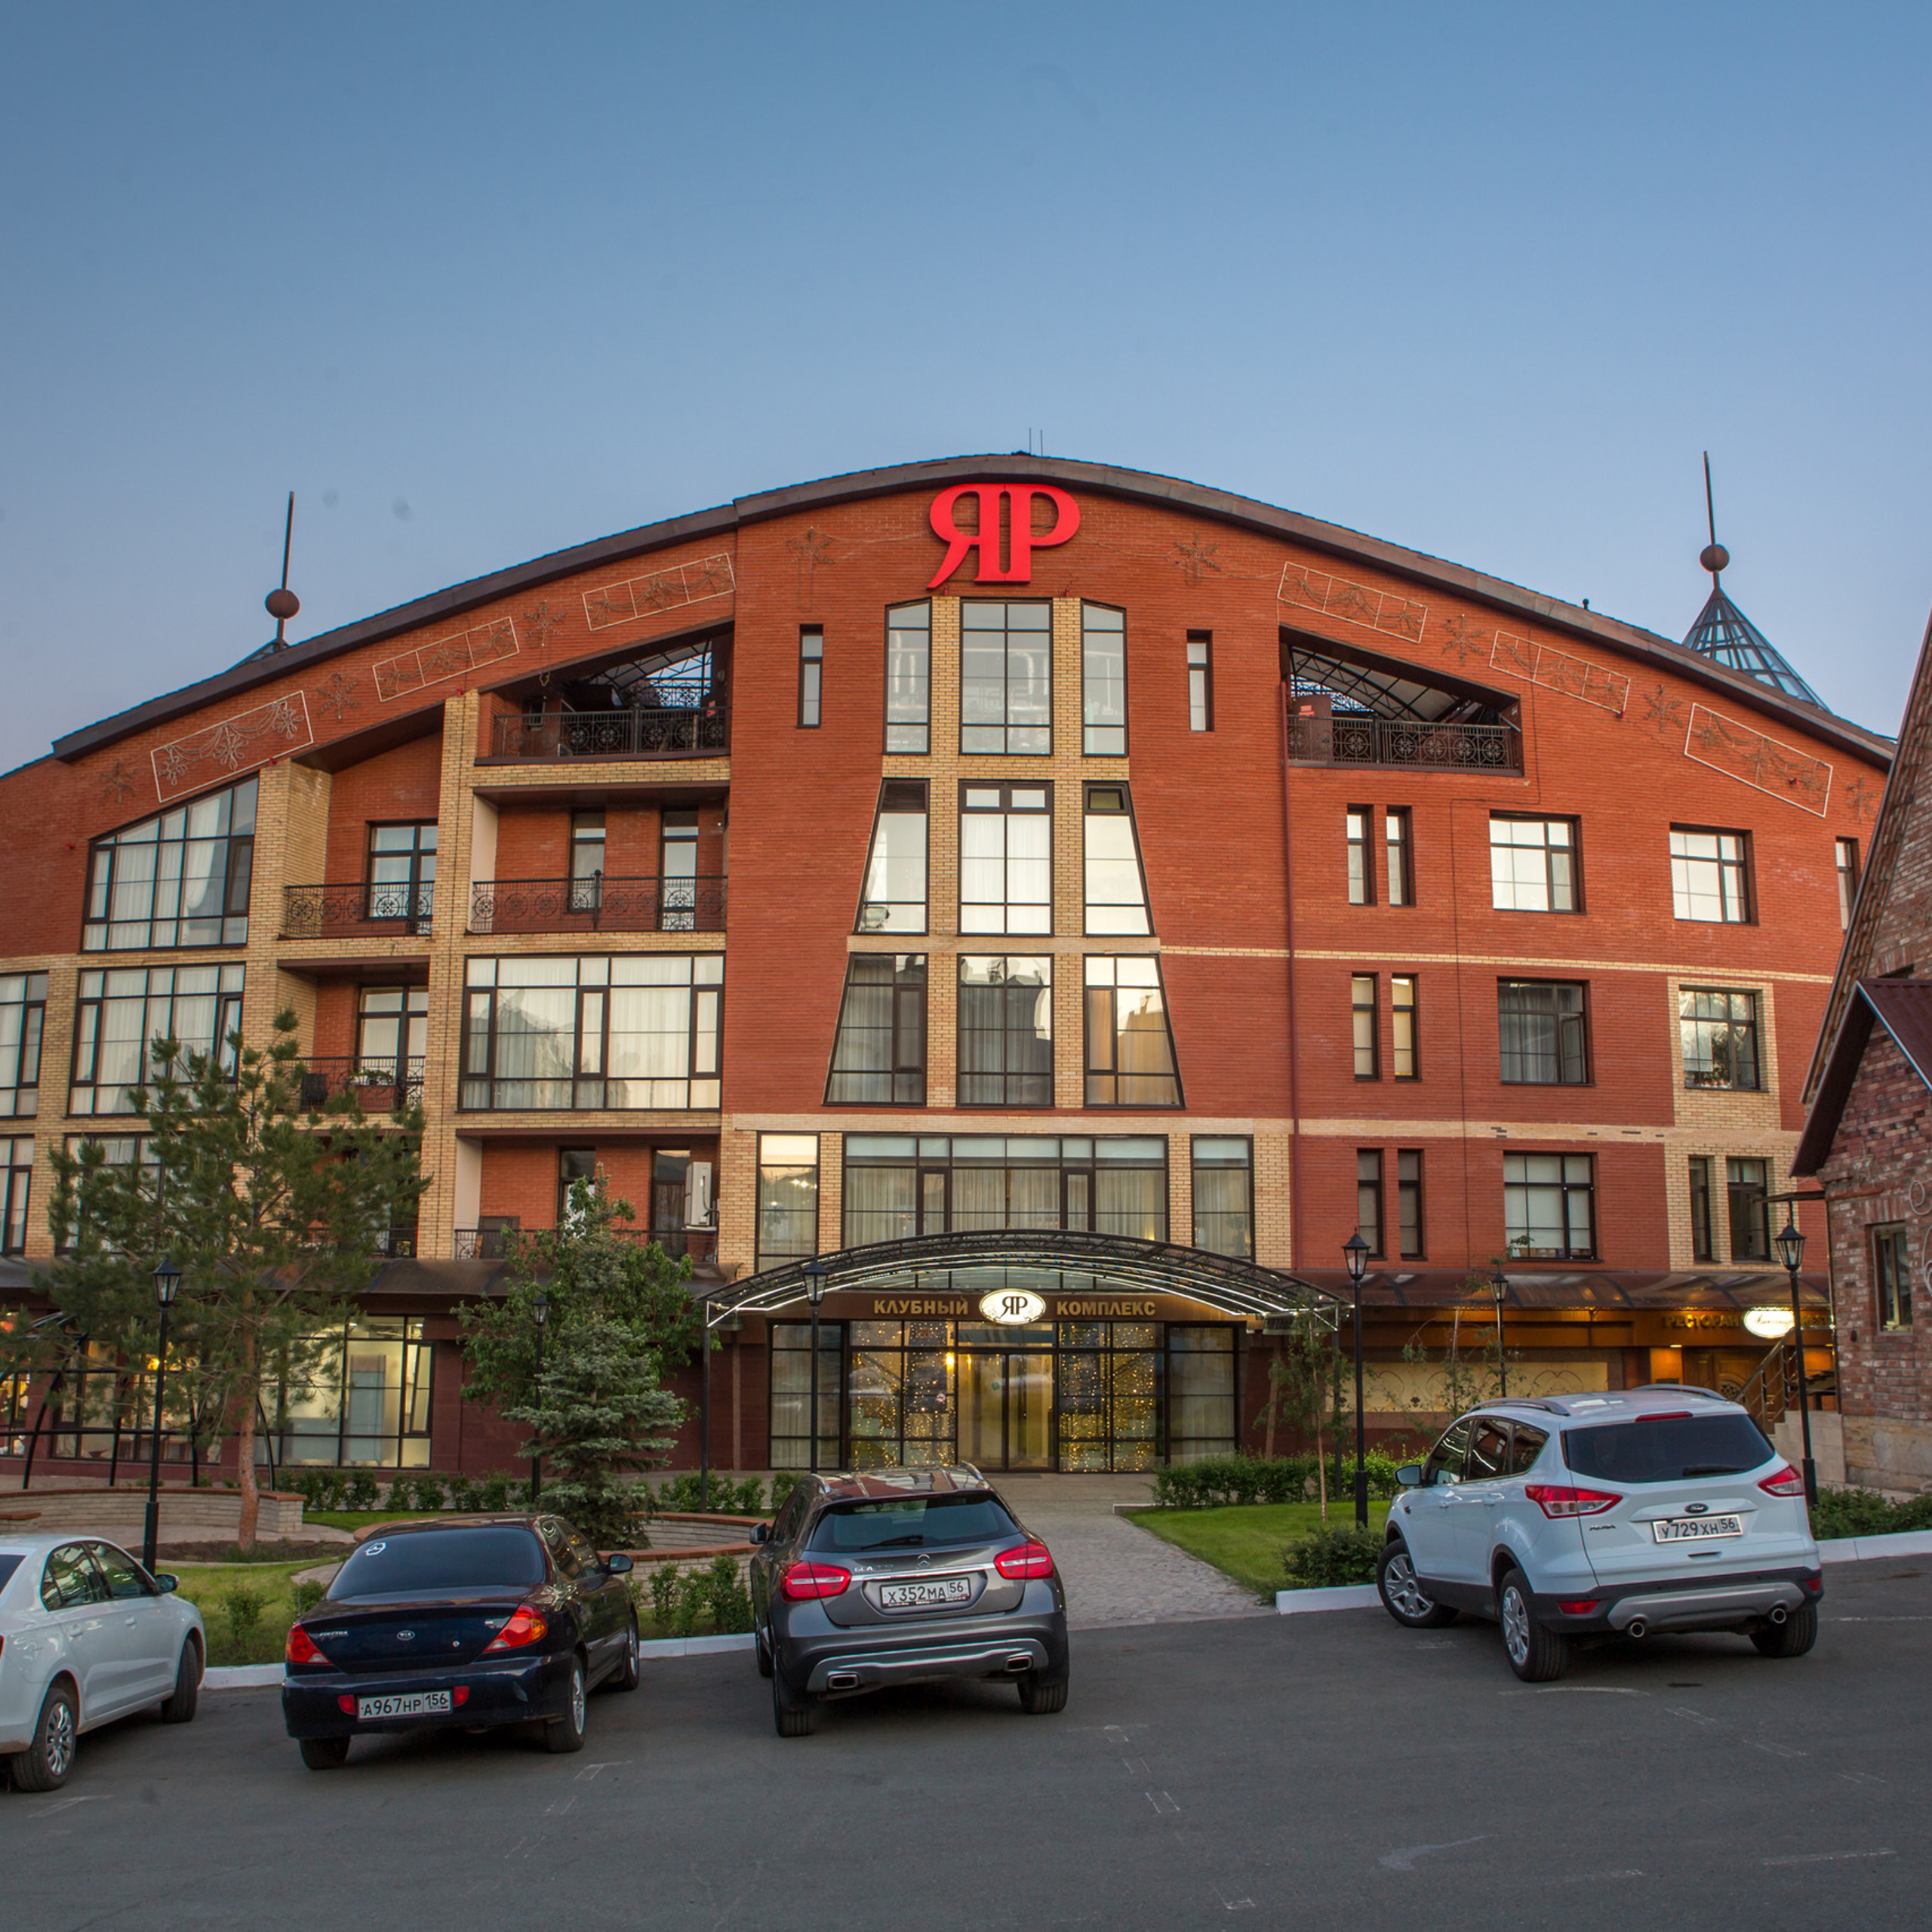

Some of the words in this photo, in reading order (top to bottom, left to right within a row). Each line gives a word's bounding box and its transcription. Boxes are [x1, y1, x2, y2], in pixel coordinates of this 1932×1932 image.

[926, 483, 1080, 590] ЯР
[874, 1296, 968, 1315] КЛУБНЫЙ
[1057, 1301, 1156, 1315] КОМПЛЕКС
[1663, 1314, 1740, 1328] РЕСТОРАН
[1721, 1518, 1736, 1530] 56
[949, 1582, 964, 1593] 56
[425, 1694, 446, 1706] 156
